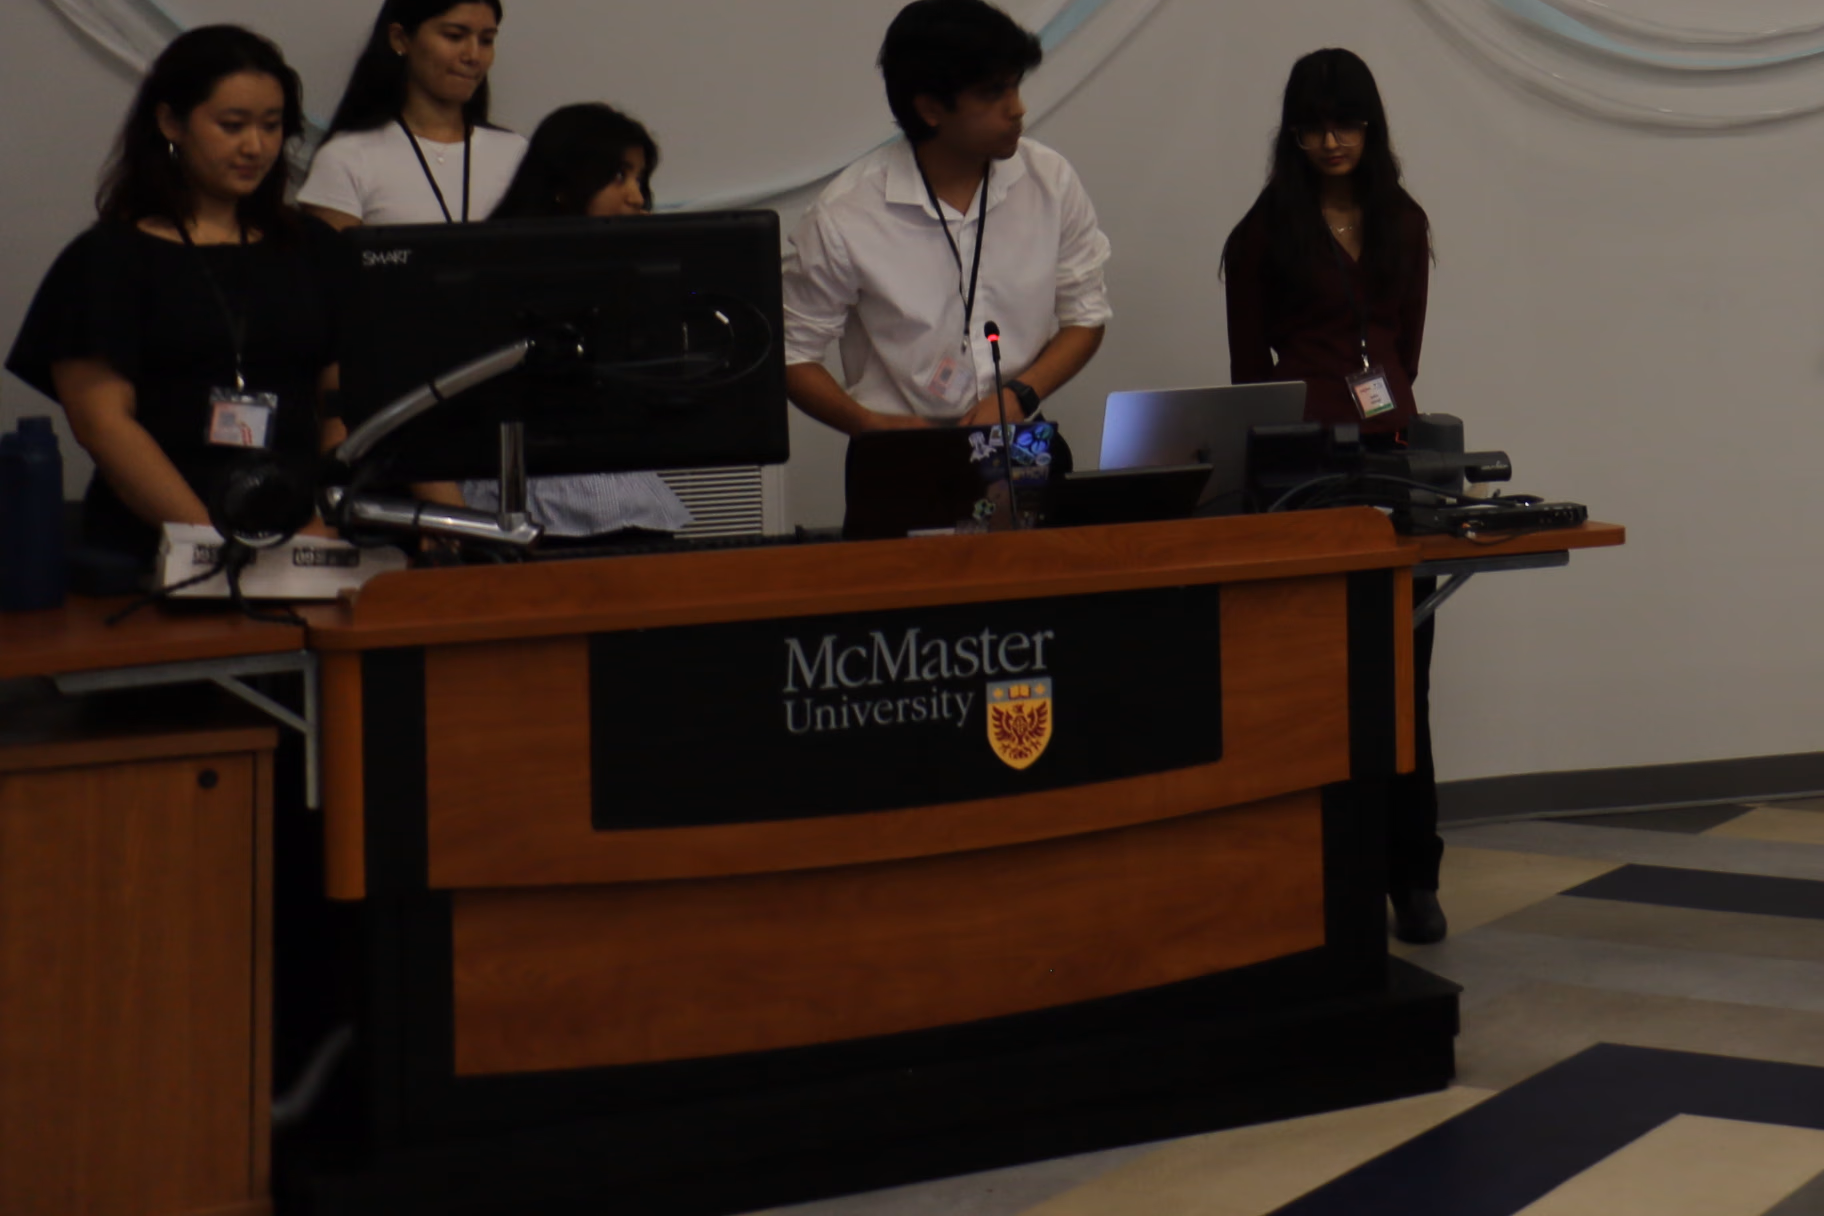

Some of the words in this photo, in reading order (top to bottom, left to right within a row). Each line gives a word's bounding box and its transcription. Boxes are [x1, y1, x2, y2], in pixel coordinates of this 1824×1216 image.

[362, 249, 409, 266] SMART
[782, 626, 1054, 694] McMaster
[783, 686, 975, 734] University
